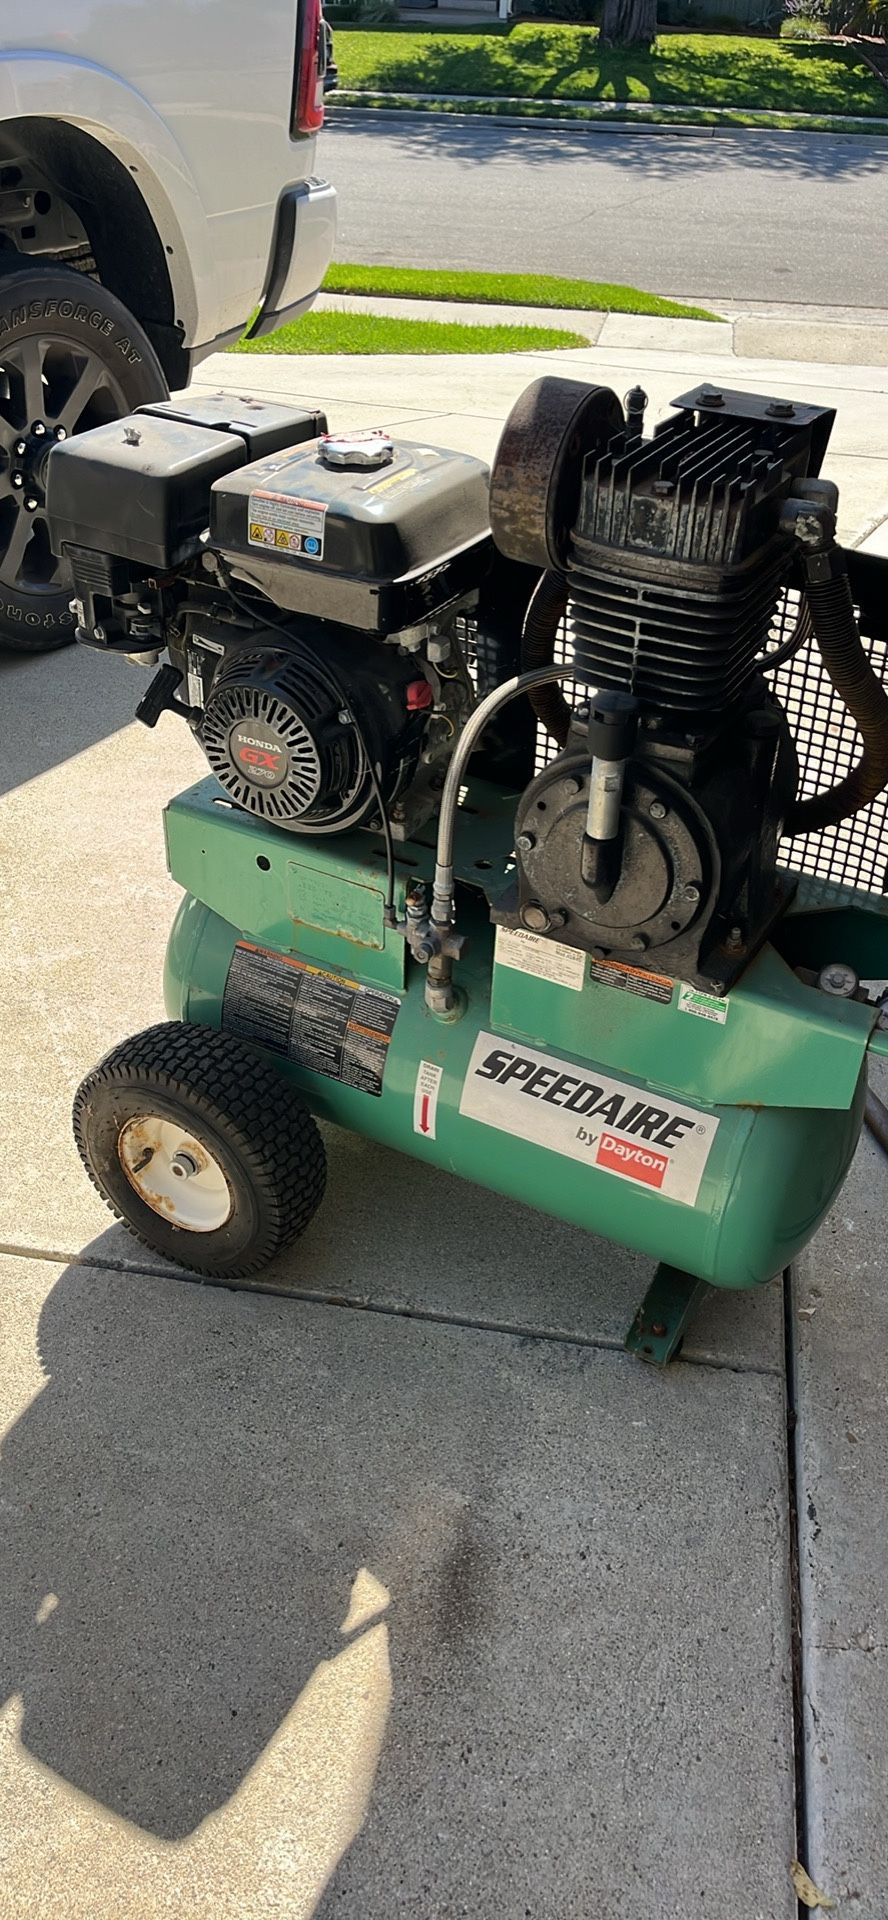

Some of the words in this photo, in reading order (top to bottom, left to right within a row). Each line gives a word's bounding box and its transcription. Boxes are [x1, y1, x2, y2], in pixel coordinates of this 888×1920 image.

[0, 300, 115, 336] ANSFORCE
[115, 338, 142, 364] AT
[238, 734, 282, 753] HONDA
[239, 747, 281, 770] GX
[248, 765, 275, 779] 270
[322, 970, 346, 985] CAUTION
[421, 1075, 438, 1085] AFTER
[423, 1069, 437, 1078] TANK
[420, 1081, 435, 1090] EACH
[474, 1050, 696, 1149] SPEEDAIRE
[576, 1126, 599, 1147] by
[601, 1134, 666, 1172] Dayton
